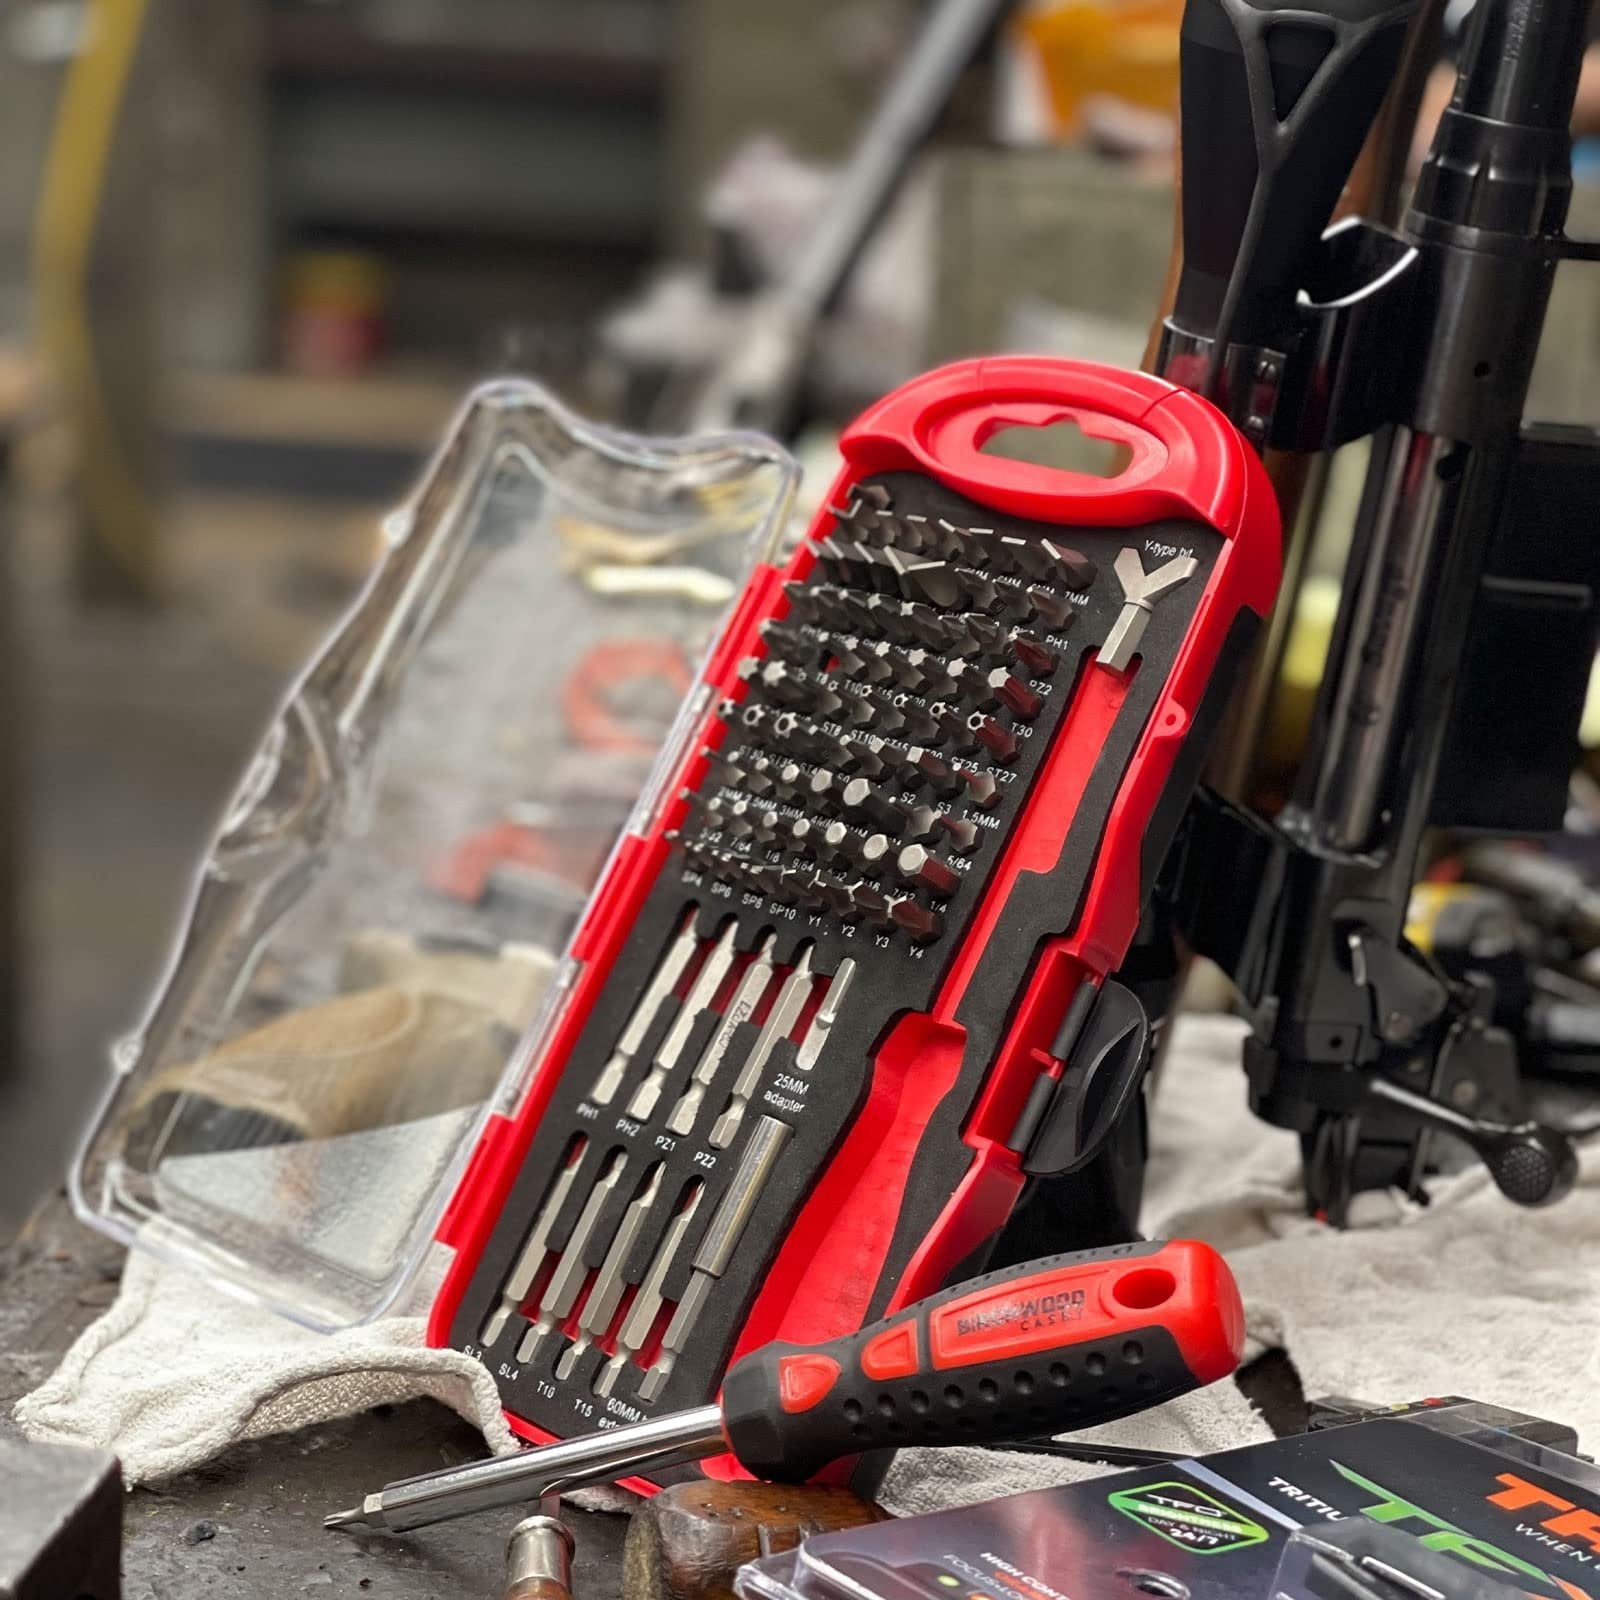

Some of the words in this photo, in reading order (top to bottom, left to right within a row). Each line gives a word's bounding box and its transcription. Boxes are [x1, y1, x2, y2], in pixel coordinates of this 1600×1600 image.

[1144, 539, 1177, 557] Y-type
[1064, 590, 1090, 607] 7MM
[1045, 634, 1069, 650] PH1
[844, 679, 863, 696] T10
[822, 720, 842, 737] ST8
[1010, 722, 1034, 738] T30
[986, 766, 1018, 784] ST27
[744, 793, 777, 812] 25MM
[900, 791, 916, 805] S2
[936, 801, 952, 815] S3
[962, 808, 1001, 829] 15MM
[765, 849, 781, 864] 1/8
[792, 857, 816, 873] 9/64
[930, 900, 948, 914] 1/4
[710, 881, 733, 899] SP6
[769, 902, 797, 920] SP10
[808, 915, 822, 928] Y1
[841, 924, 856, 938] Y2
[875, 934, 890, 948] Y3
[909, 945, 925, 959] Y4
[773, 1072, 810, 1096] 25MM
[762, 1088, 806, 1114] adapter
[575, 1103, 599, 1121] PH1
[615, 1118, 642, 1138] PH2
[654, 1134, 677, 1152] PZ1
[692, 1150, 717, 1169] PZ2
[463, 1344, 482, 1362] SL3
[498, 1362, 519, 1381] SL4
[535, 1380, 556, 1399] T10
[573, 1398, 594, 1418] T15
[606, 1397, 642, 1423] 60MM
[1267, 1475, 1350, 1522] TRITIU
[1169, 1528, 1219, 1545] 24/7
[1514, 1522, 1593, 1563] WHEN
[980, 1552, 1025, 1577] HIGH
